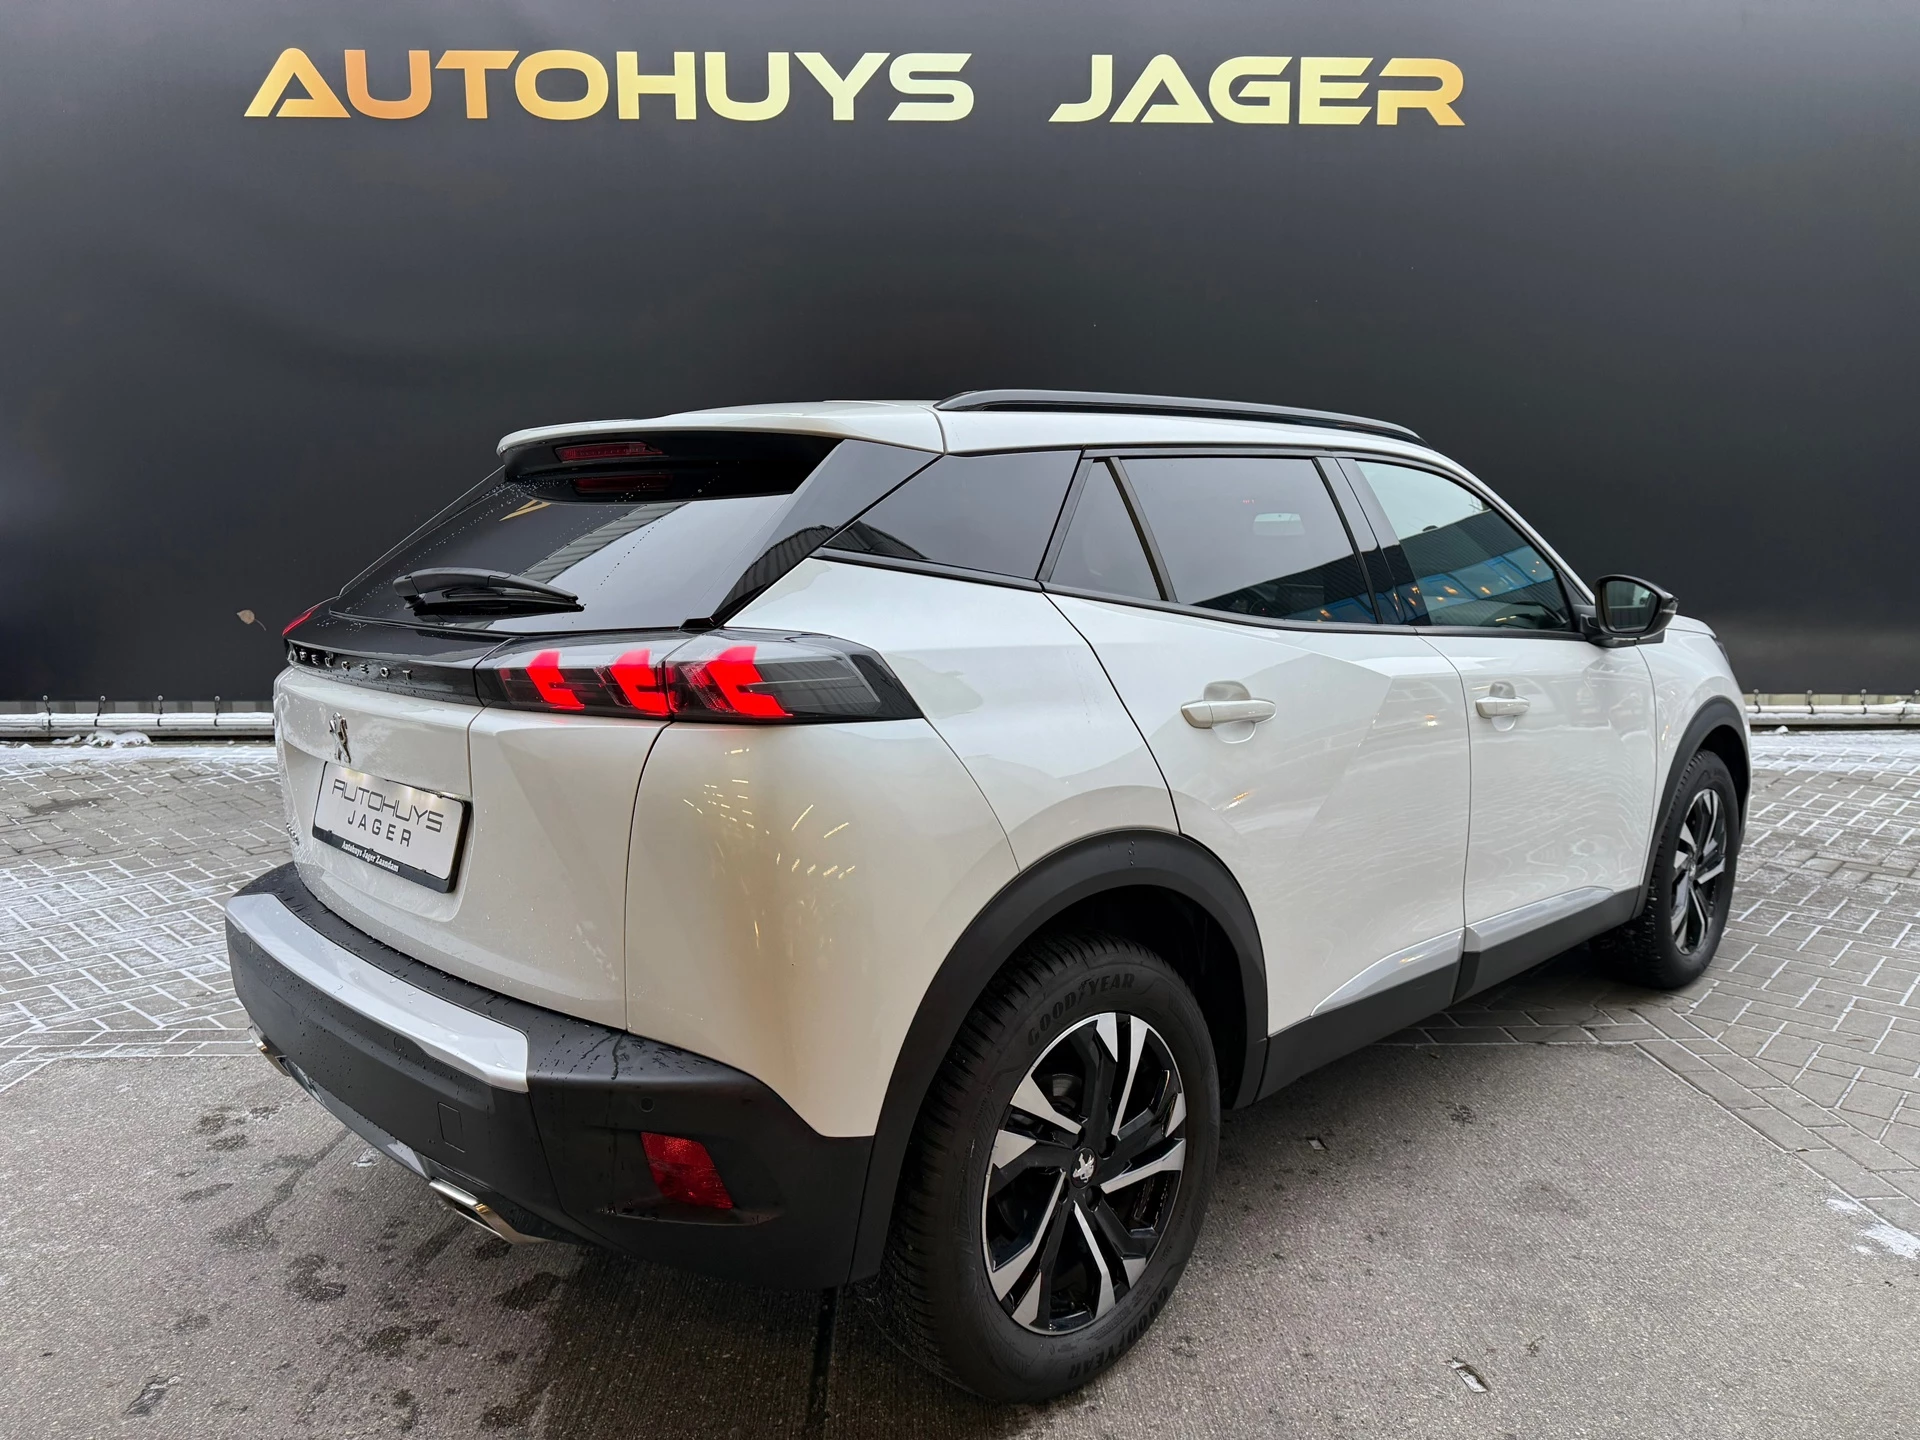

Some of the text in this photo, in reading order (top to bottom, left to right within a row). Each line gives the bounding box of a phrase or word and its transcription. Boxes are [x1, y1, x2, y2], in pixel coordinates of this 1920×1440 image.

[244, 47, 1466, 127] AUTOHUYS JAGER
[331, 778, 444, 833] AUTOHUYS
[347, 809, 412, 847] JAGER
[341, 840, 399, 873] Autohuys Jager Zaandam
